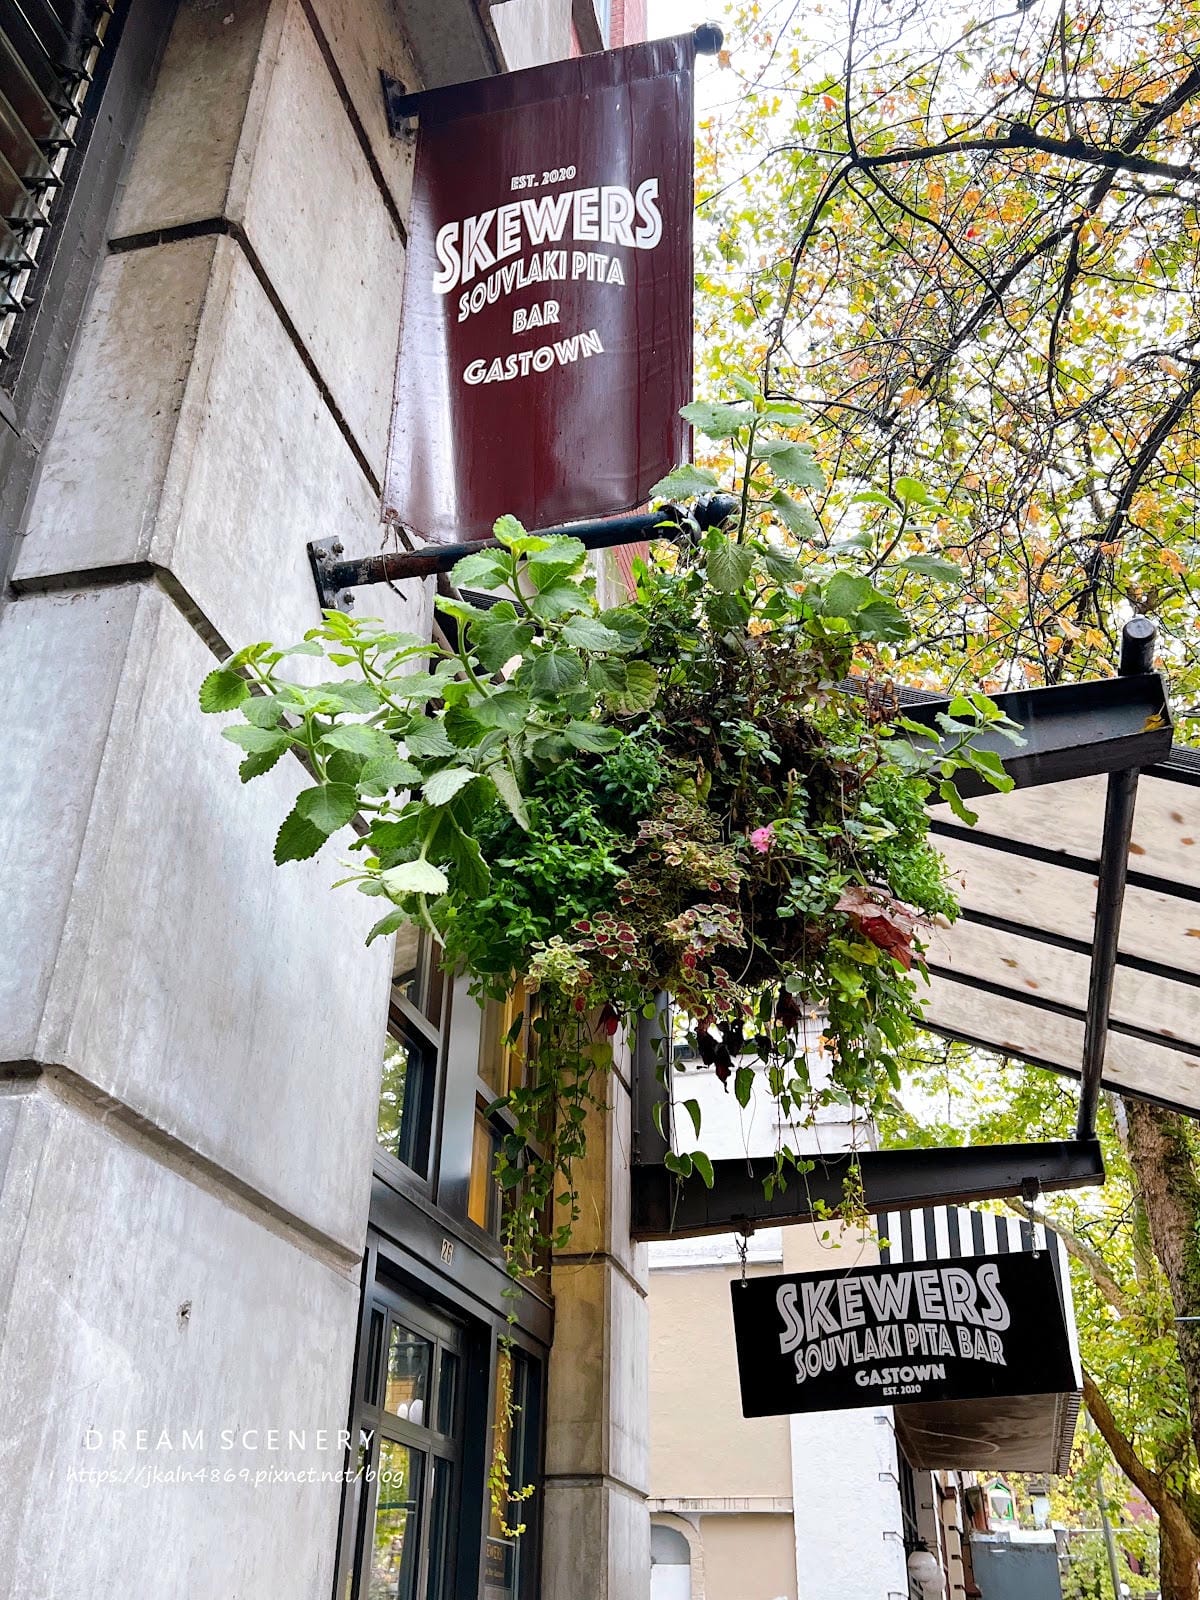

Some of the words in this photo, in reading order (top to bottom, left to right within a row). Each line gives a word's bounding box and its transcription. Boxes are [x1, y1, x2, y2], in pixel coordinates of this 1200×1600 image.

[510, 174, 539, 190] EST.
[541, 165, 576, 185] 2020
[432, 178, 662, 295] SKEWERS
[458, 250, 567, 322] SOUVLAKI
[571, 251, 625, 286] PITA
[512, 300, 560, 334] BAR
[463, 329, 605, 385] GASTOWN
[775, 1263, 1011, 1354] SKEWERS
[794, 1324, 901, 1384] SOUVLAKI
[906, 1323, 956, 1357] PITA
[958, 1325, 1007, 1366] BAR
[855, 1363, 946, 1387] GASTOWN
[882, 1385, 900, 1396] EST.
[901, 1383, 922, 1395] 2020
